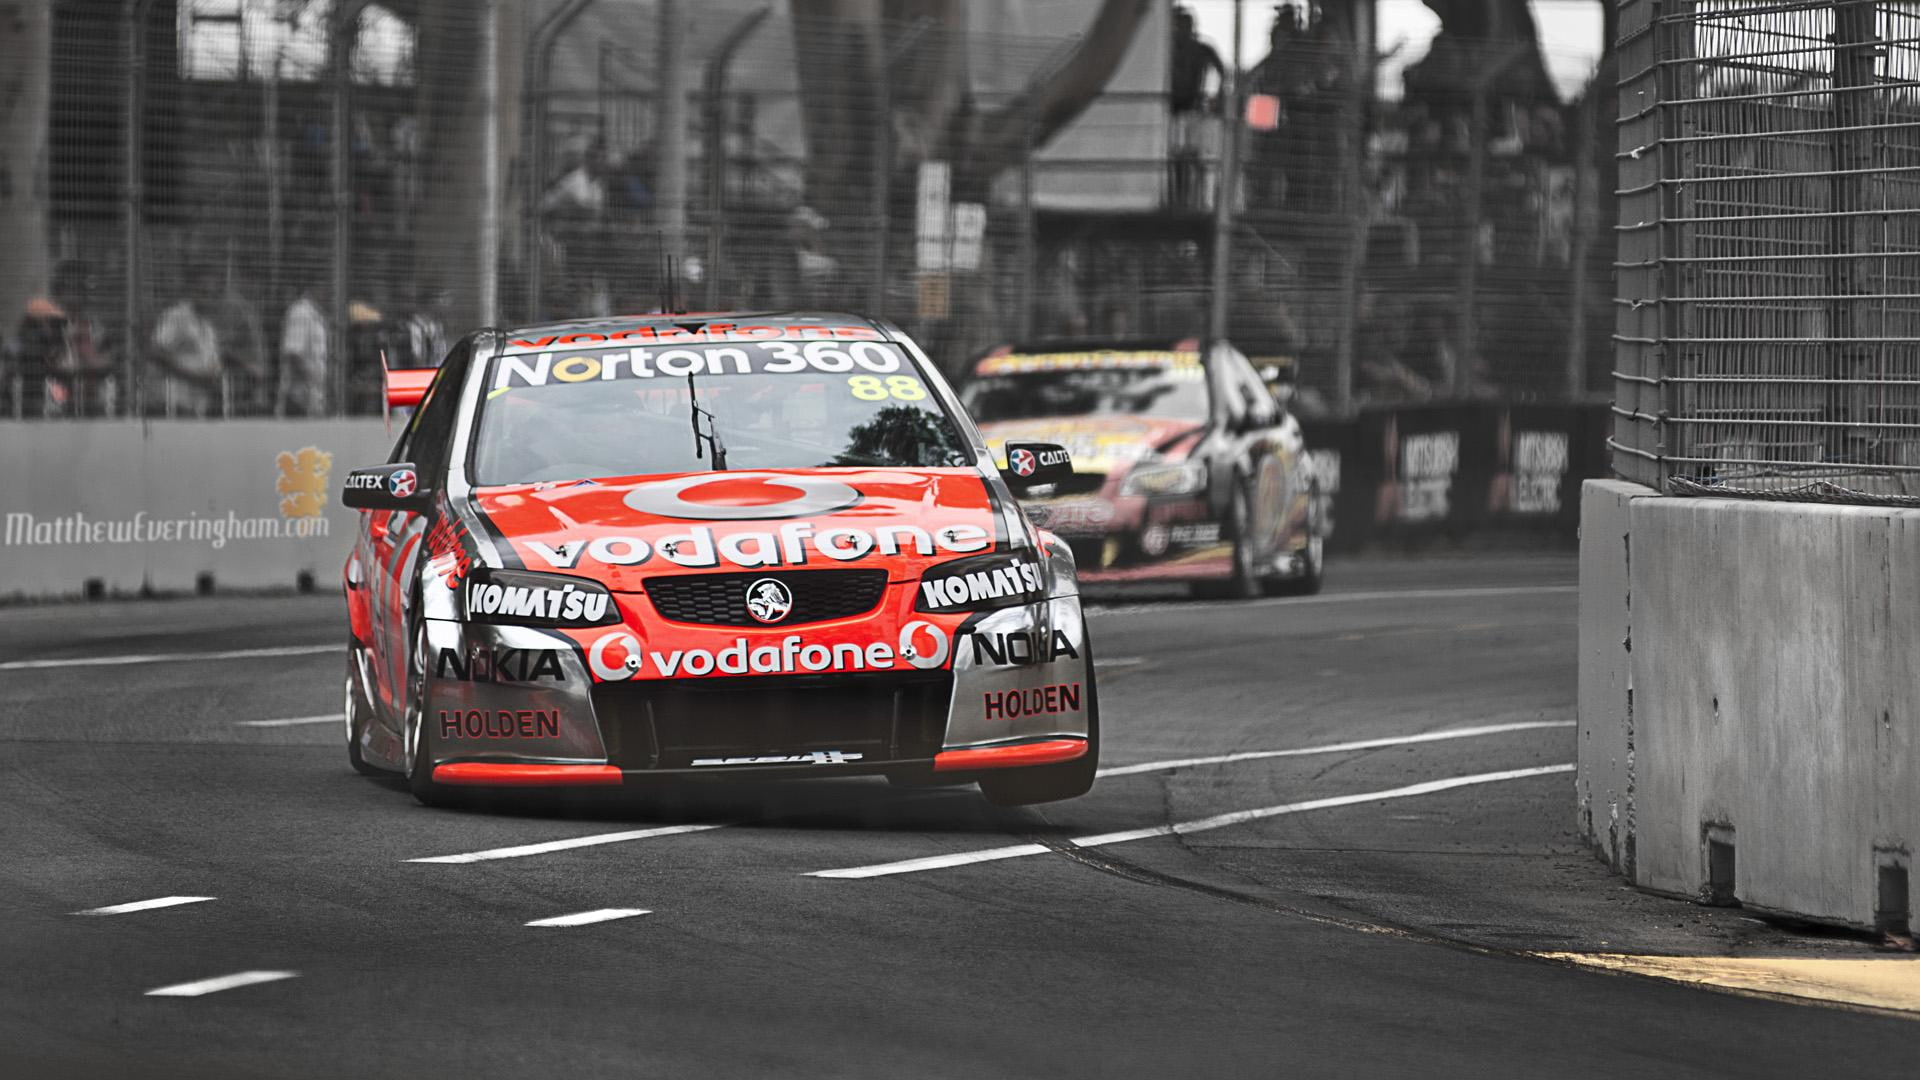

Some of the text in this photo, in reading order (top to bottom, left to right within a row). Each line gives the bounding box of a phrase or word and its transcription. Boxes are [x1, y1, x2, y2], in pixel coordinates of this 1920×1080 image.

[494, 341, 900, 389] Norton 360
[847, 375, 926, 401] 88
[524, 521, 990, 569] vodafone
[470, 583, 609, 622] KOMATSU
[920, 557, 1043, 609] KOMATSU
[436, 647, 566, 681] NOKIA
[650, 636, 895, 677] vodafone
[984, 683, 1081, 721] HOLDEN
[439, 708, 561, 739] HOLDEN
